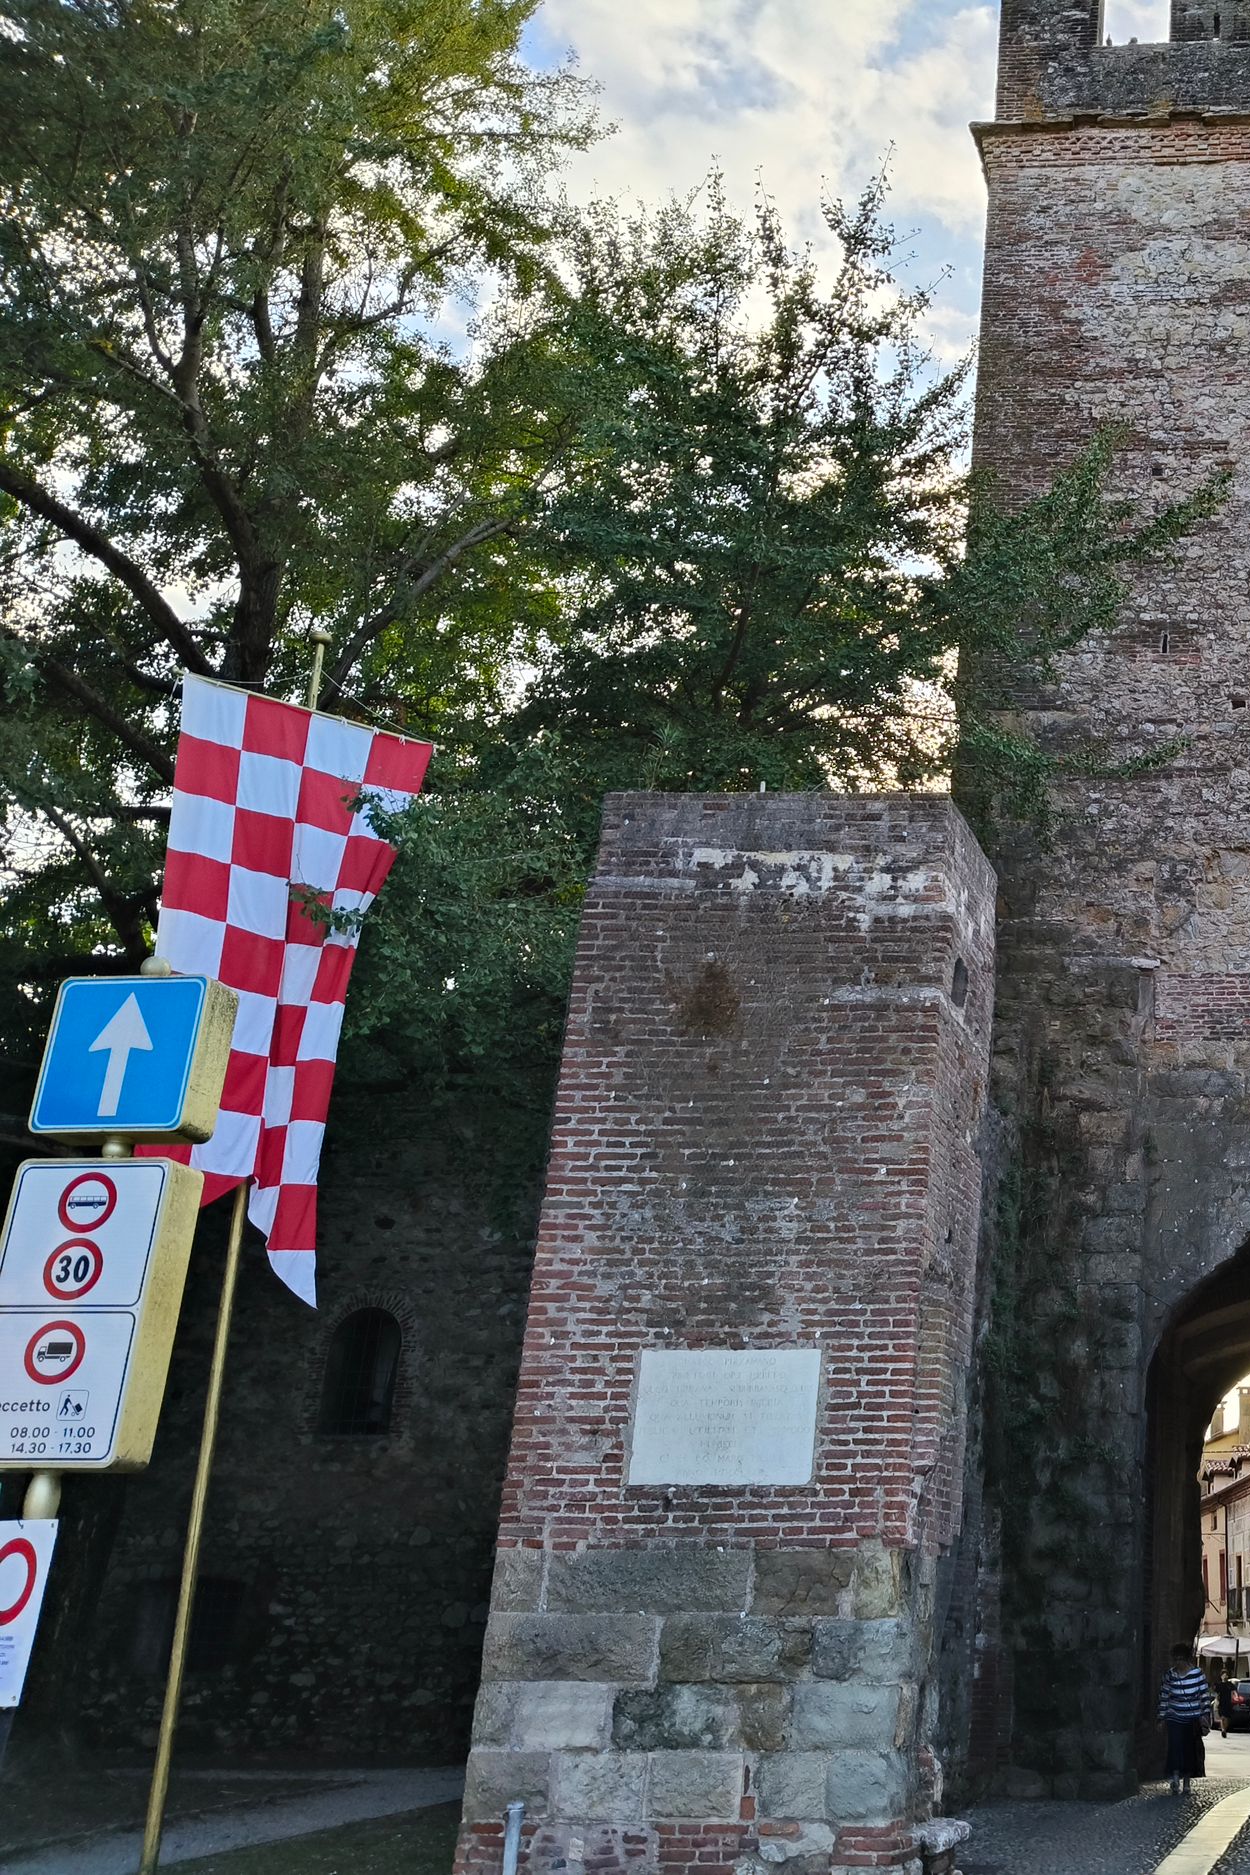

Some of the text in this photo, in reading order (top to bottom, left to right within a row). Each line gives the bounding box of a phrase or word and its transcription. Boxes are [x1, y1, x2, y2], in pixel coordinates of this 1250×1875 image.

[55, 1254, 90, 1283] 30
[0, 1399, 50, 1412] ccetto
[10, 1426, 51, 1438] 08.00
[63, 1426, 96, 1438] 11.00
[11, 1442, 47, 1454] 14.30
[58, 1442, 92, 1454] 17.30
